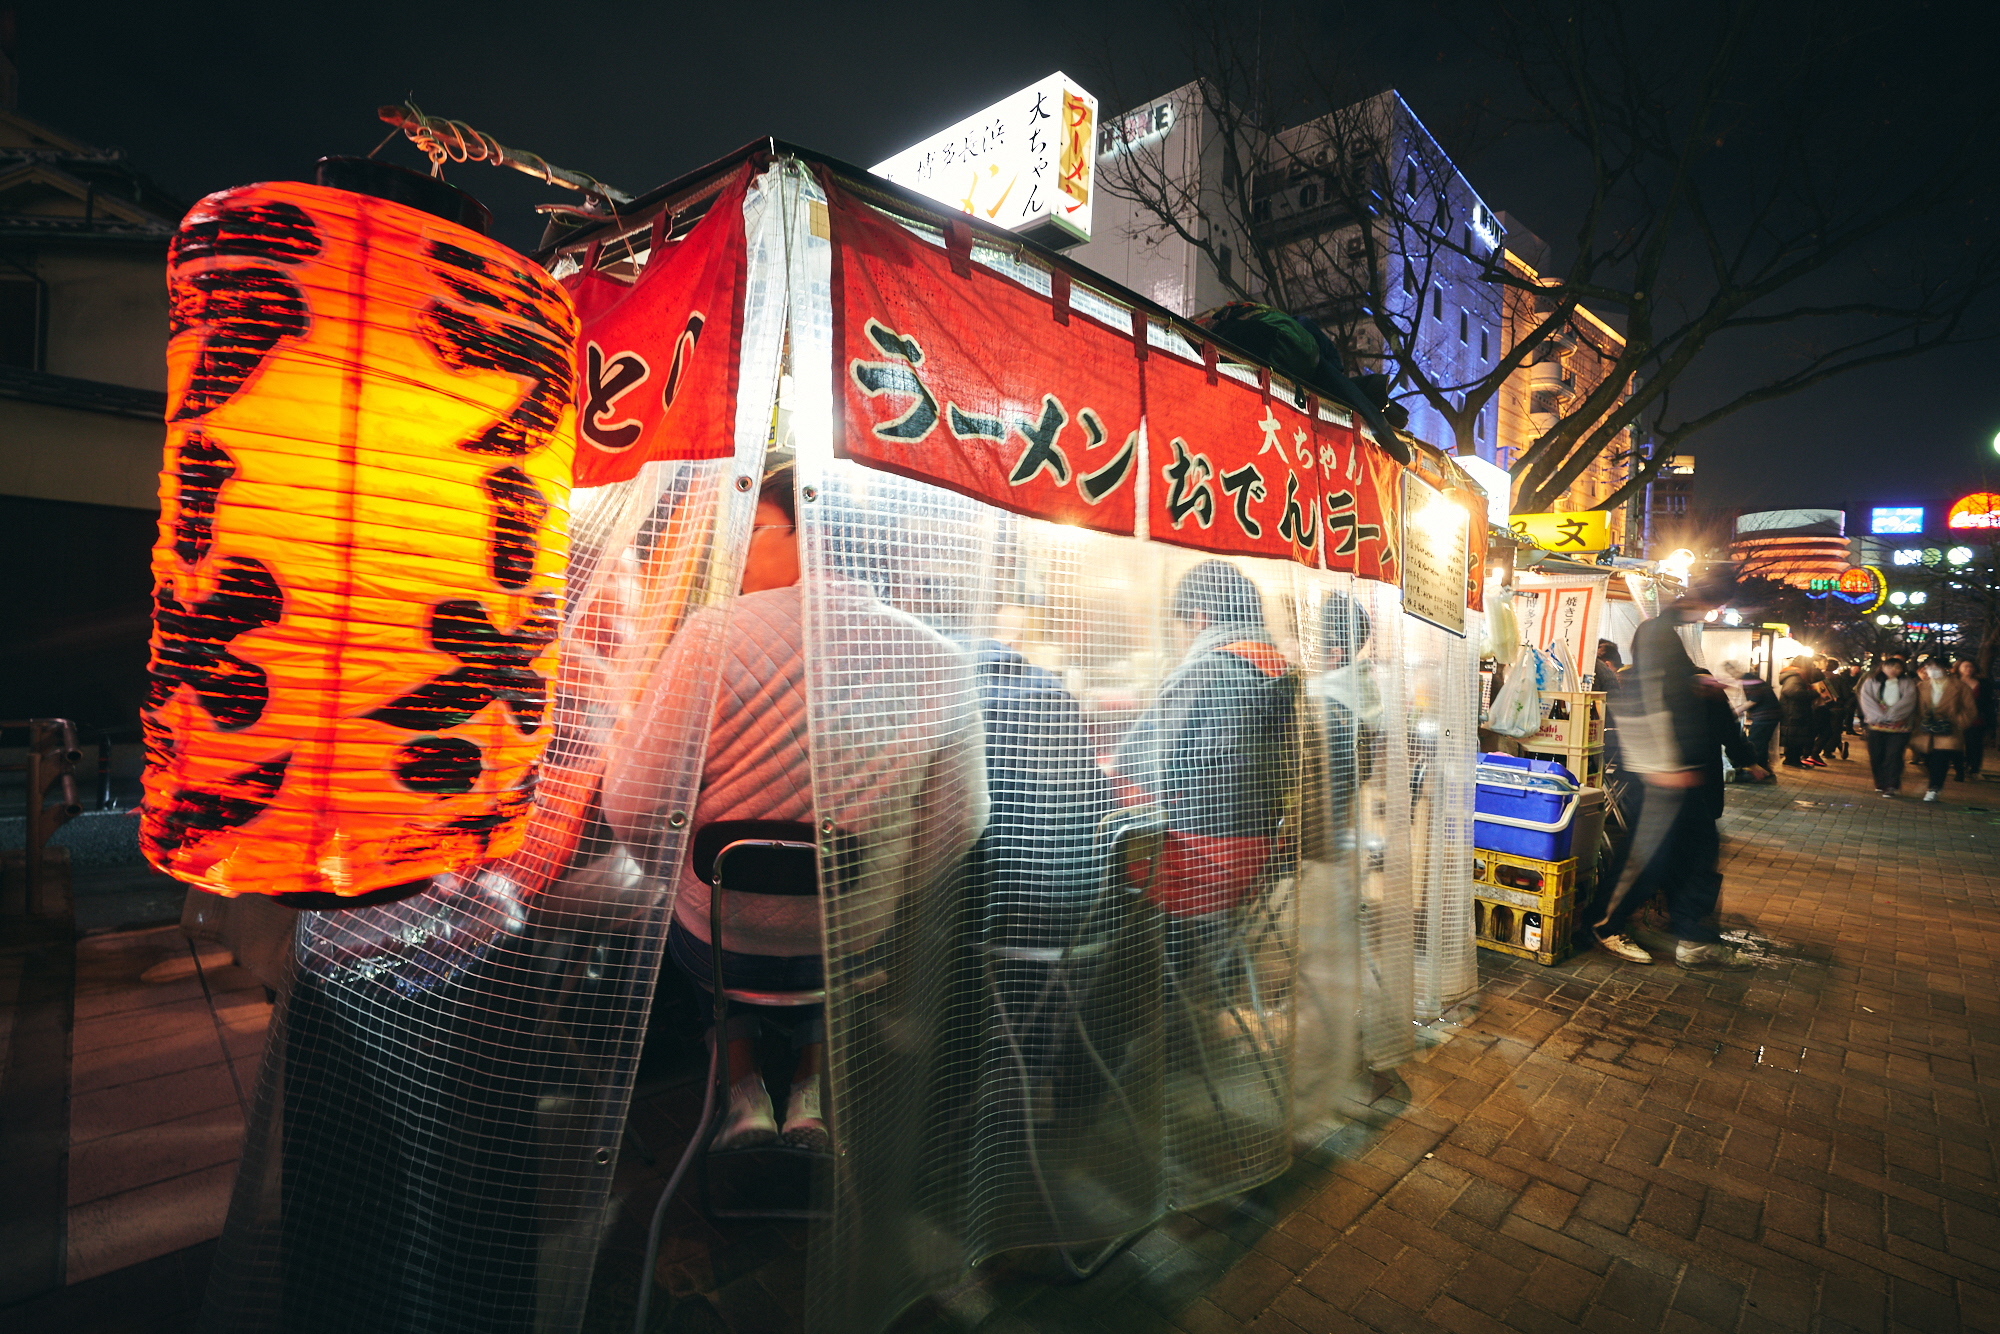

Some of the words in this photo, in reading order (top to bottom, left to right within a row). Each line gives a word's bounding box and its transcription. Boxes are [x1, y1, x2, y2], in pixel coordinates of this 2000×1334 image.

[1023, 91, 1051, 217] 大ちゃん
[1064, 94, 1087, 214] ラーメン
[850, 317, 1138, 506] ラーメン
[1257, 405, 1364, 486] 大ちゃん
[1162, 436, 1317, 550] おでん
[1539, 725, 1558, 733] sahi
